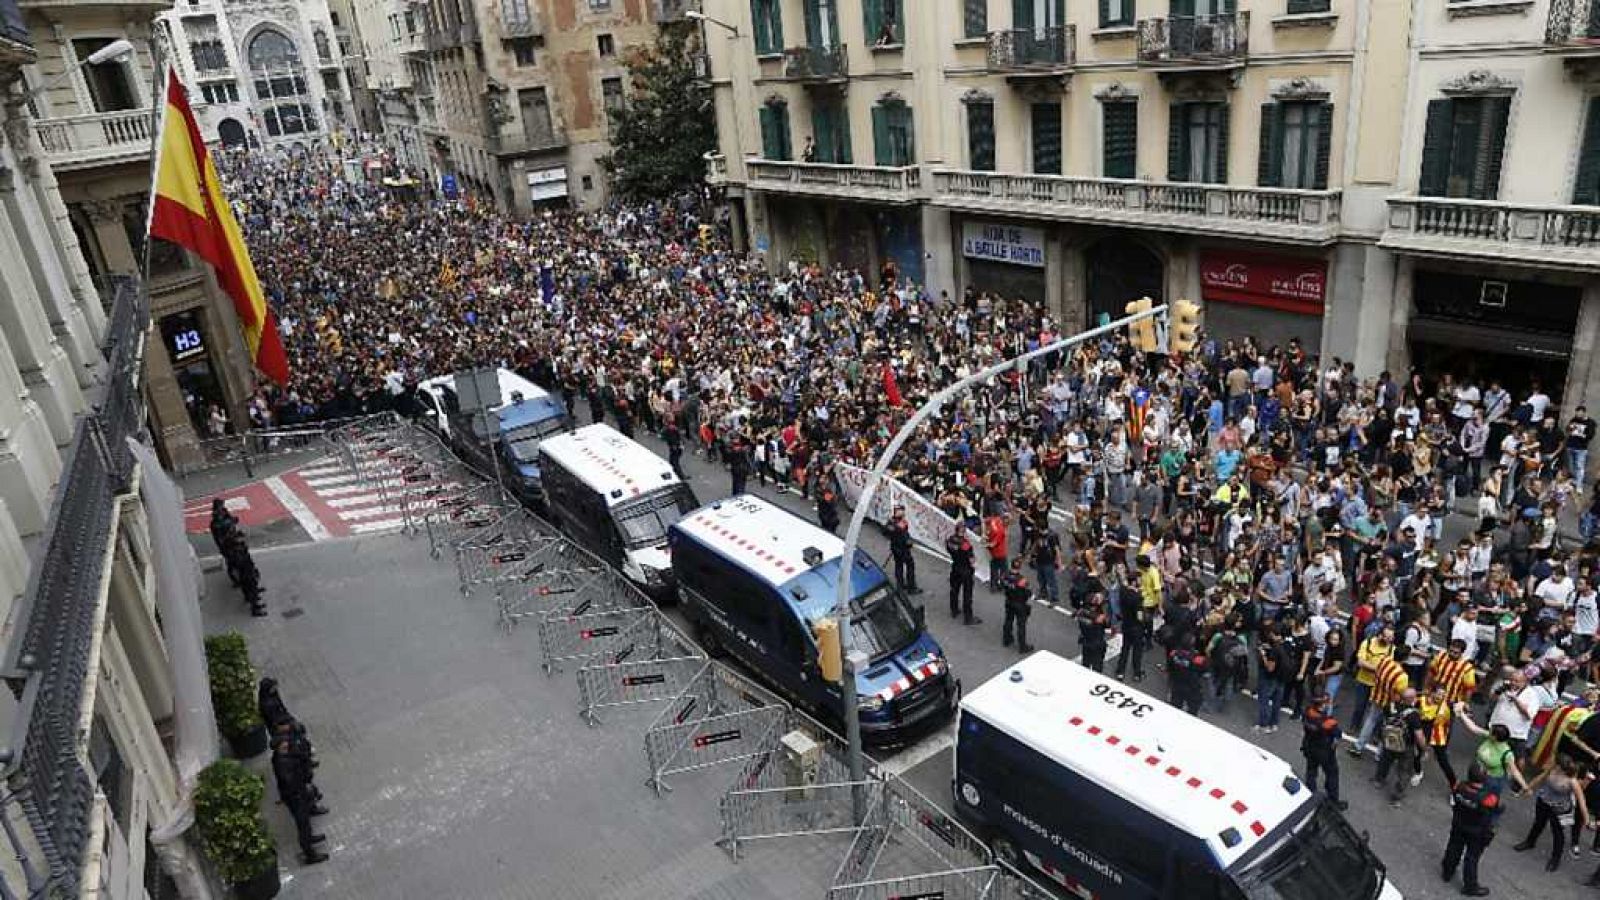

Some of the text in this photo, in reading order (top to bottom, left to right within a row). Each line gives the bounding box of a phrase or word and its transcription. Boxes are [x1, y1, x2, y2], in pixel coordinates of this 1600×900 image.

[175, 330, 201, 351] H3
[1089, 684, 1154, 718] 3436
[1003, 803, 1049, 839] mossos
